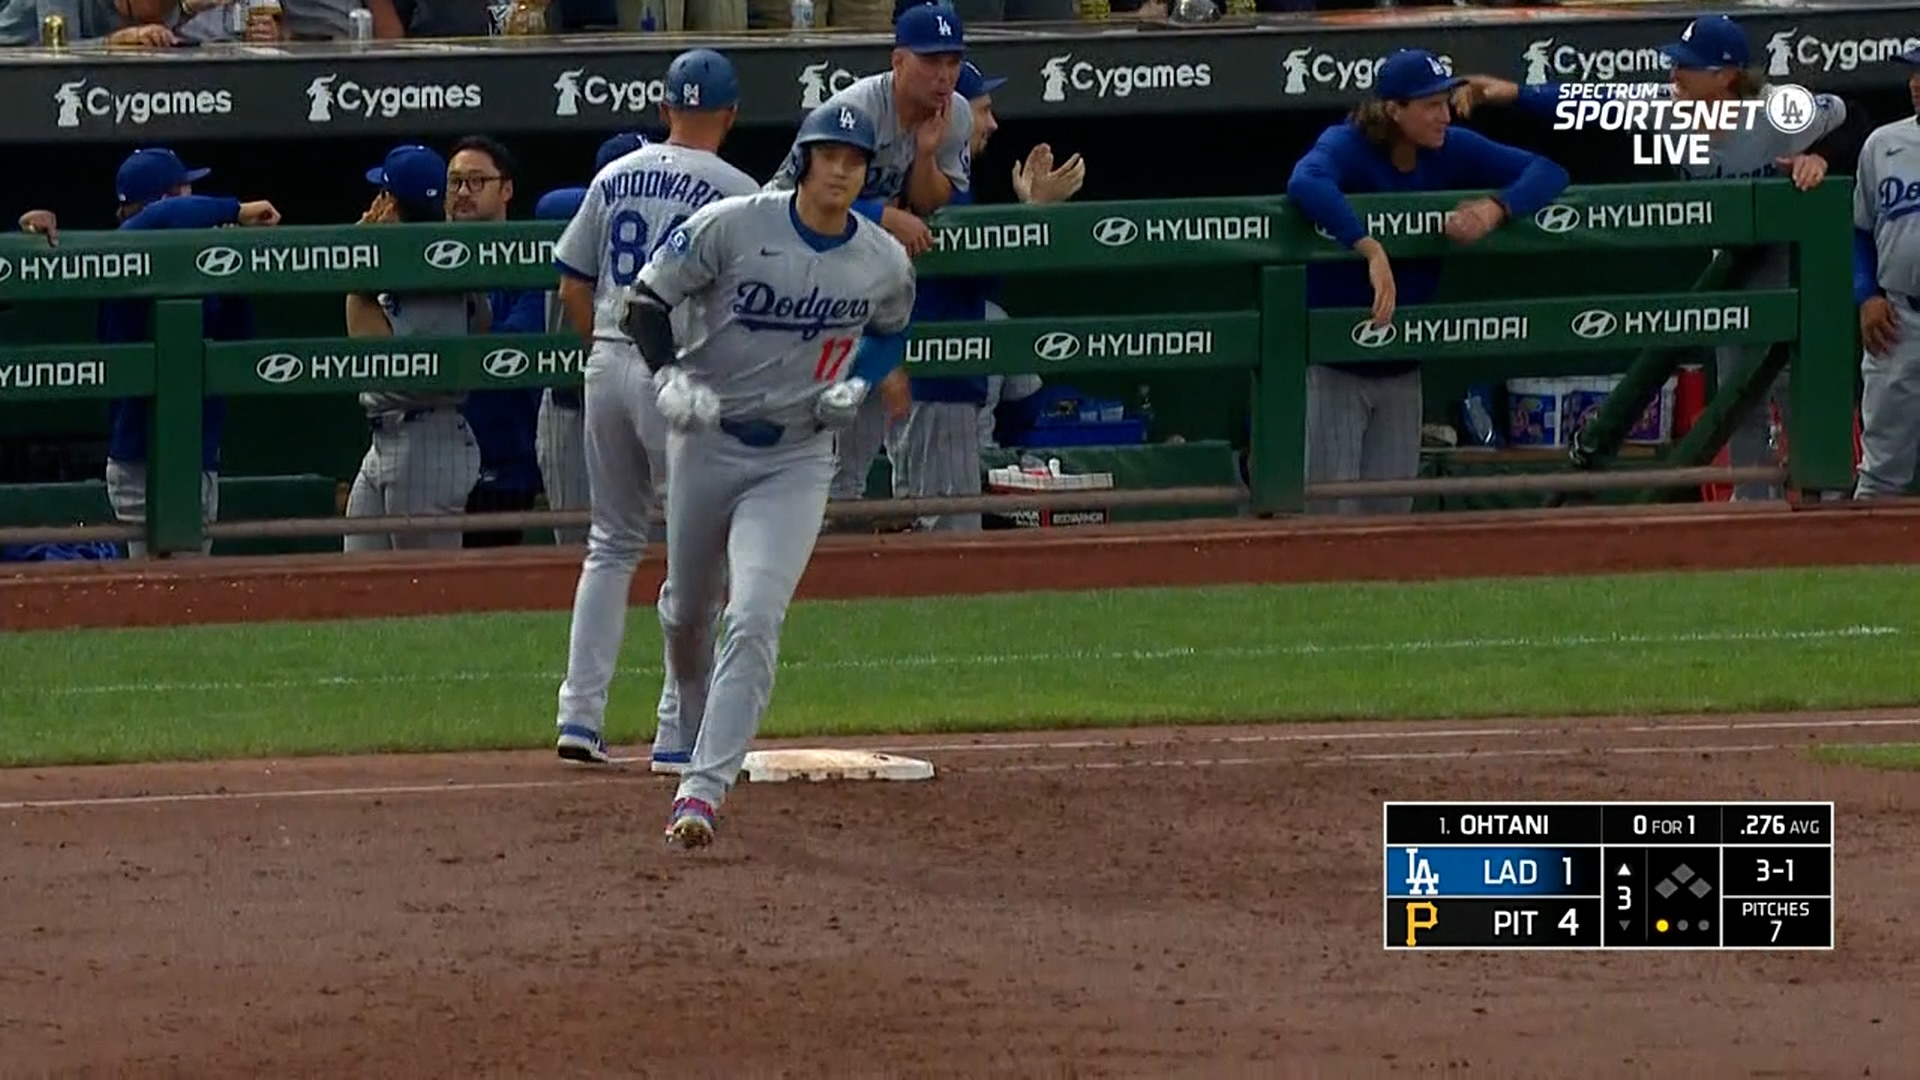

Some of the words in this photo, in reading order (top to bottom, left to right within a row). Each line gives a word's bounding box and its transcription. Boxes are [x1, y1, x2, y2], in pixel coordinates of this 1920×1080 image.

[937, 16, 952, 36] LA
[1554, 45, 1673, 81] Cygame
[1797, 35, 1920, 72] Cygame
[1071, 61, 1211, 96] Cygames
[86, 87, 232, 124] Cygames
[335, 80, 481, 117] Cygames
[585, 76, 665, 112] Cyga
[840, 107, 855, 129] LA
[1367, 210, 1455, 236] HYUN
[1588, 202, 1712, 229] HYUNDAI
[1146, 217, 1269, 241] HYUNDAI
[251, 245, 379, 271] HYUNDAI
[479, 240, 556, 265] HYUN
[21, 253, 150, 280] HYUNDAI
[733, 280, 869, 340] Dodgers
[1625, 306, 1749, 334] HYUNDAI
[1405, 317, 1528, 343] HYUNDAI
[905, 337, 990, 362] UNDAI
[1088, 331, 1212, 357] HYUNDAI
[311, 353, 438, 379] HYUNDAI
[814, 336, 855, 382] 17
[0, 361, 104, 387] YUNDAI
